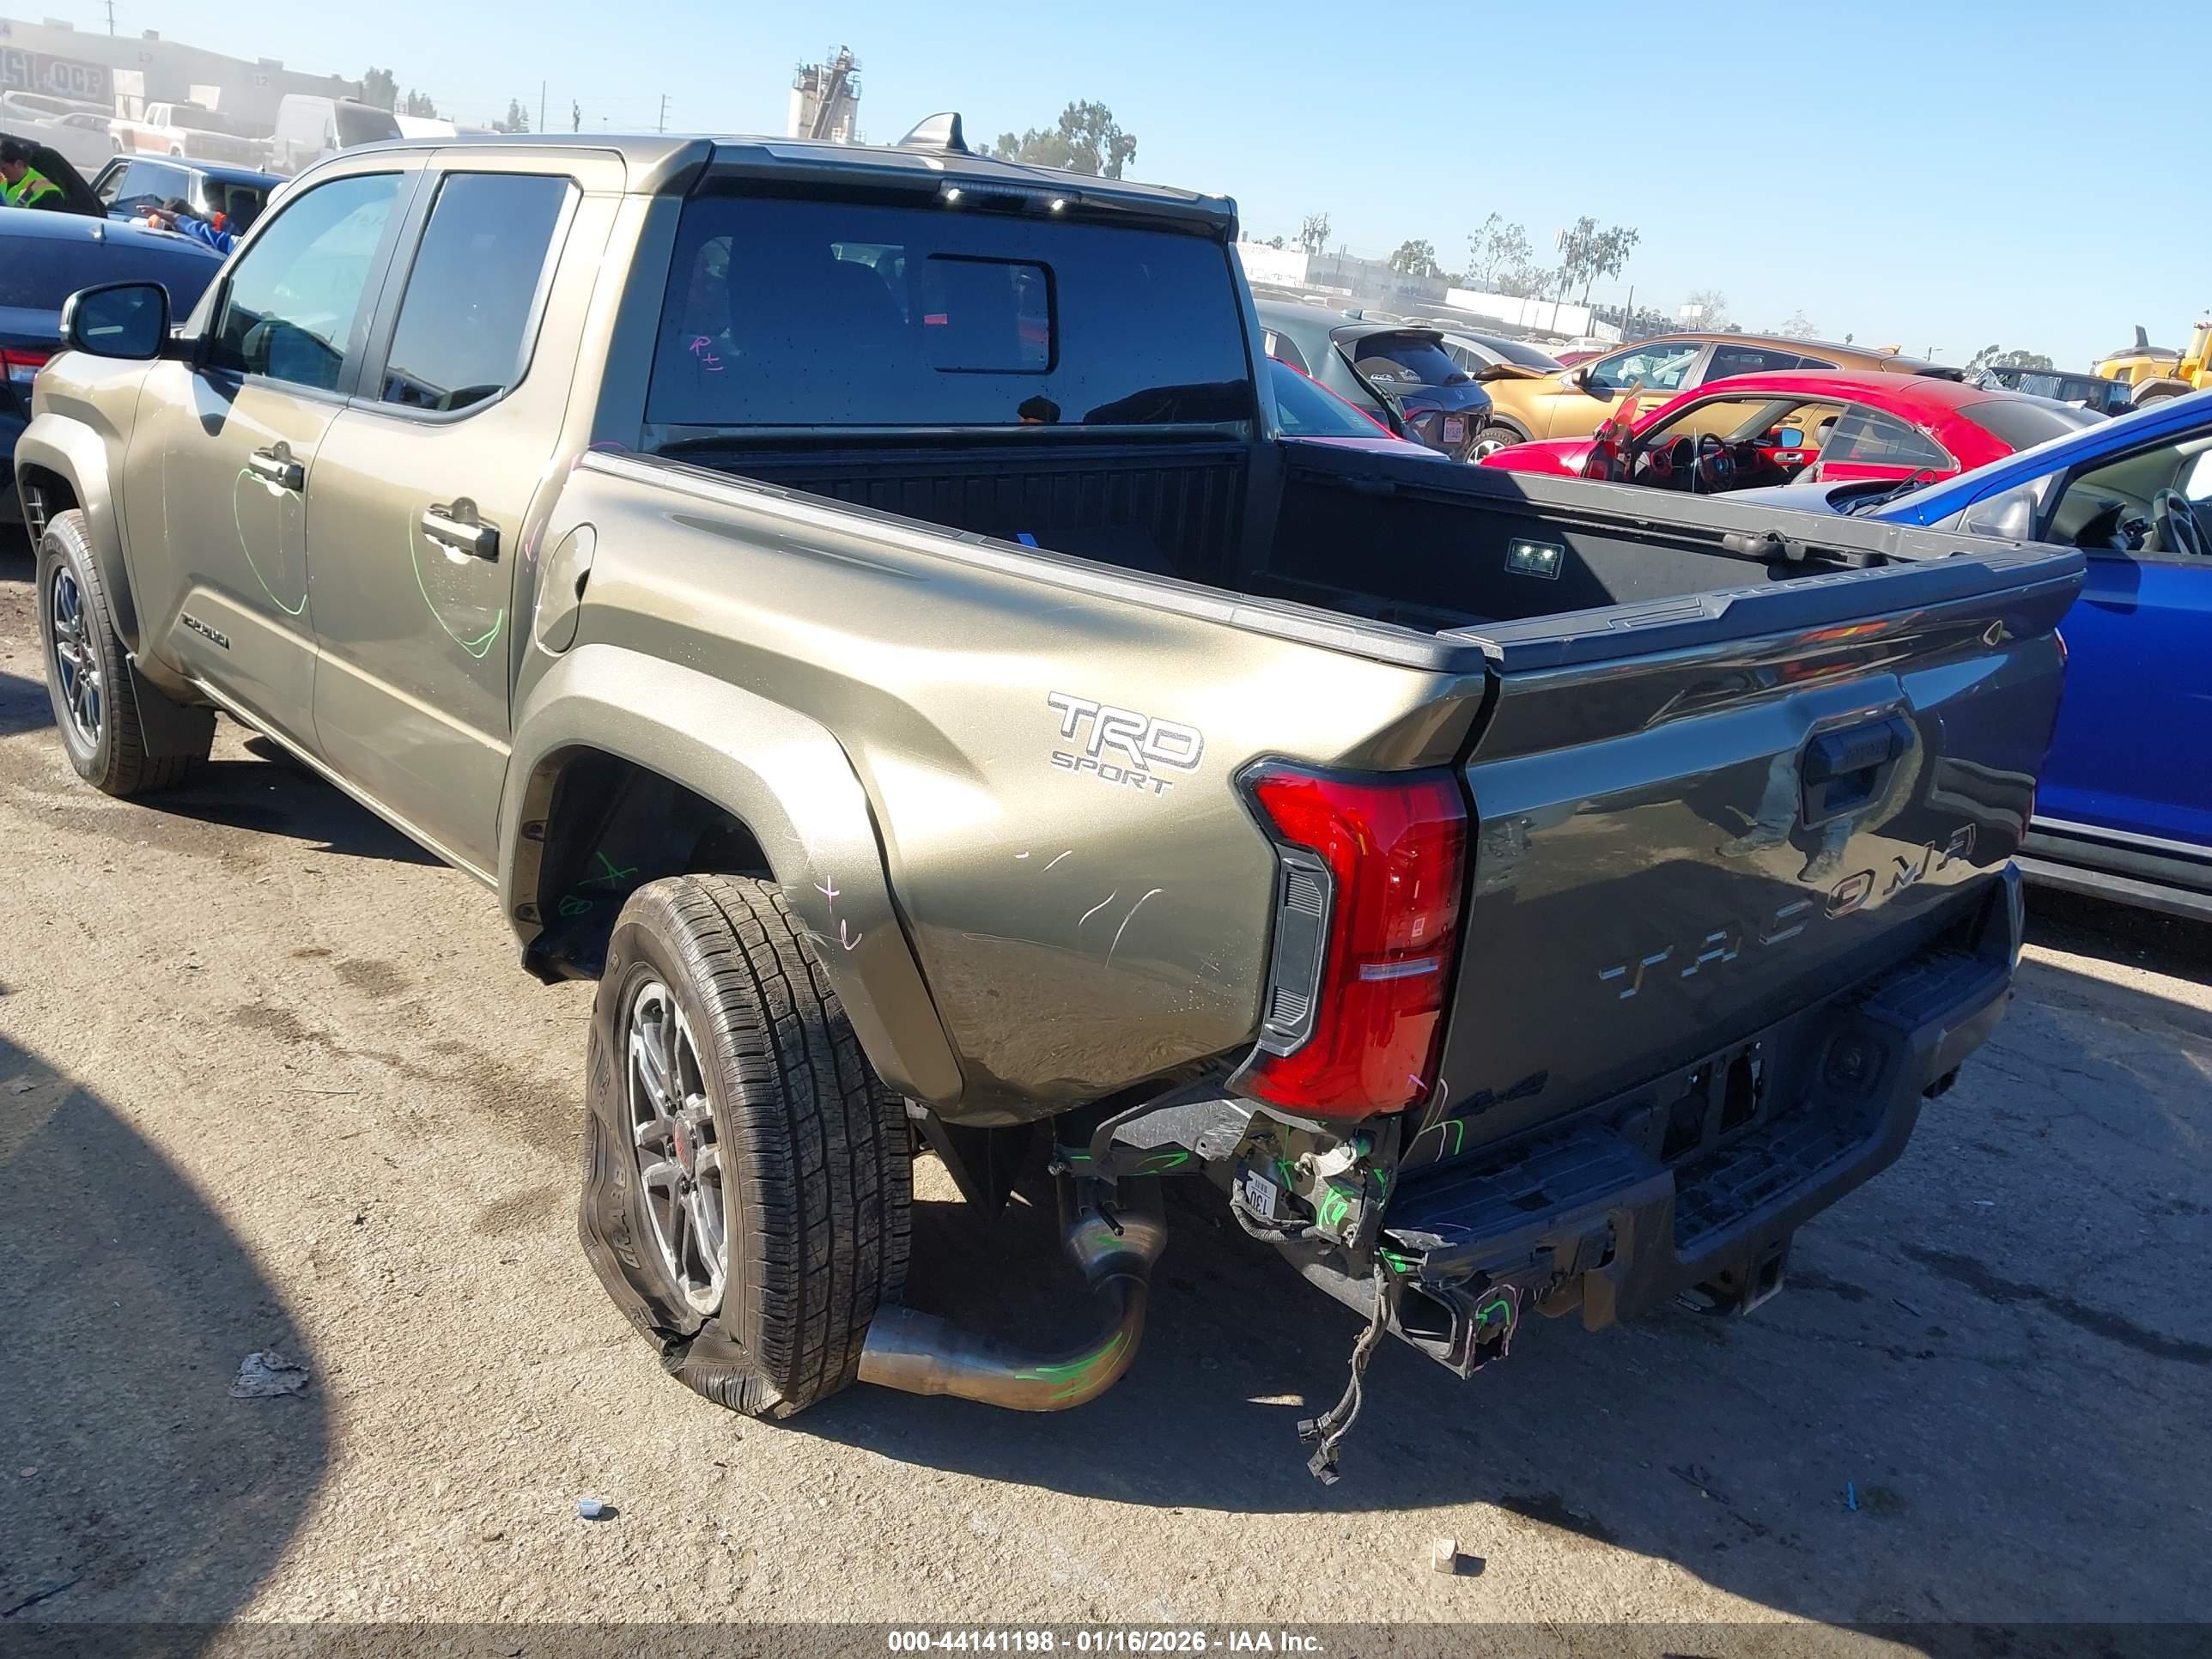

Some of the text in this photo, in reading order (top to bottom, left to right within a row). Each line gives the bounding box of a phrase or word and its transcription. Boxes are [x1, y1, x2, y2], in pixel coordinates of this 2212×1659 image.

[1048, 690, 1204, 772] TRD
[1050, 750, 1174, 795] SPORT
[1599, 823, 1977, 1000] TACOMA
